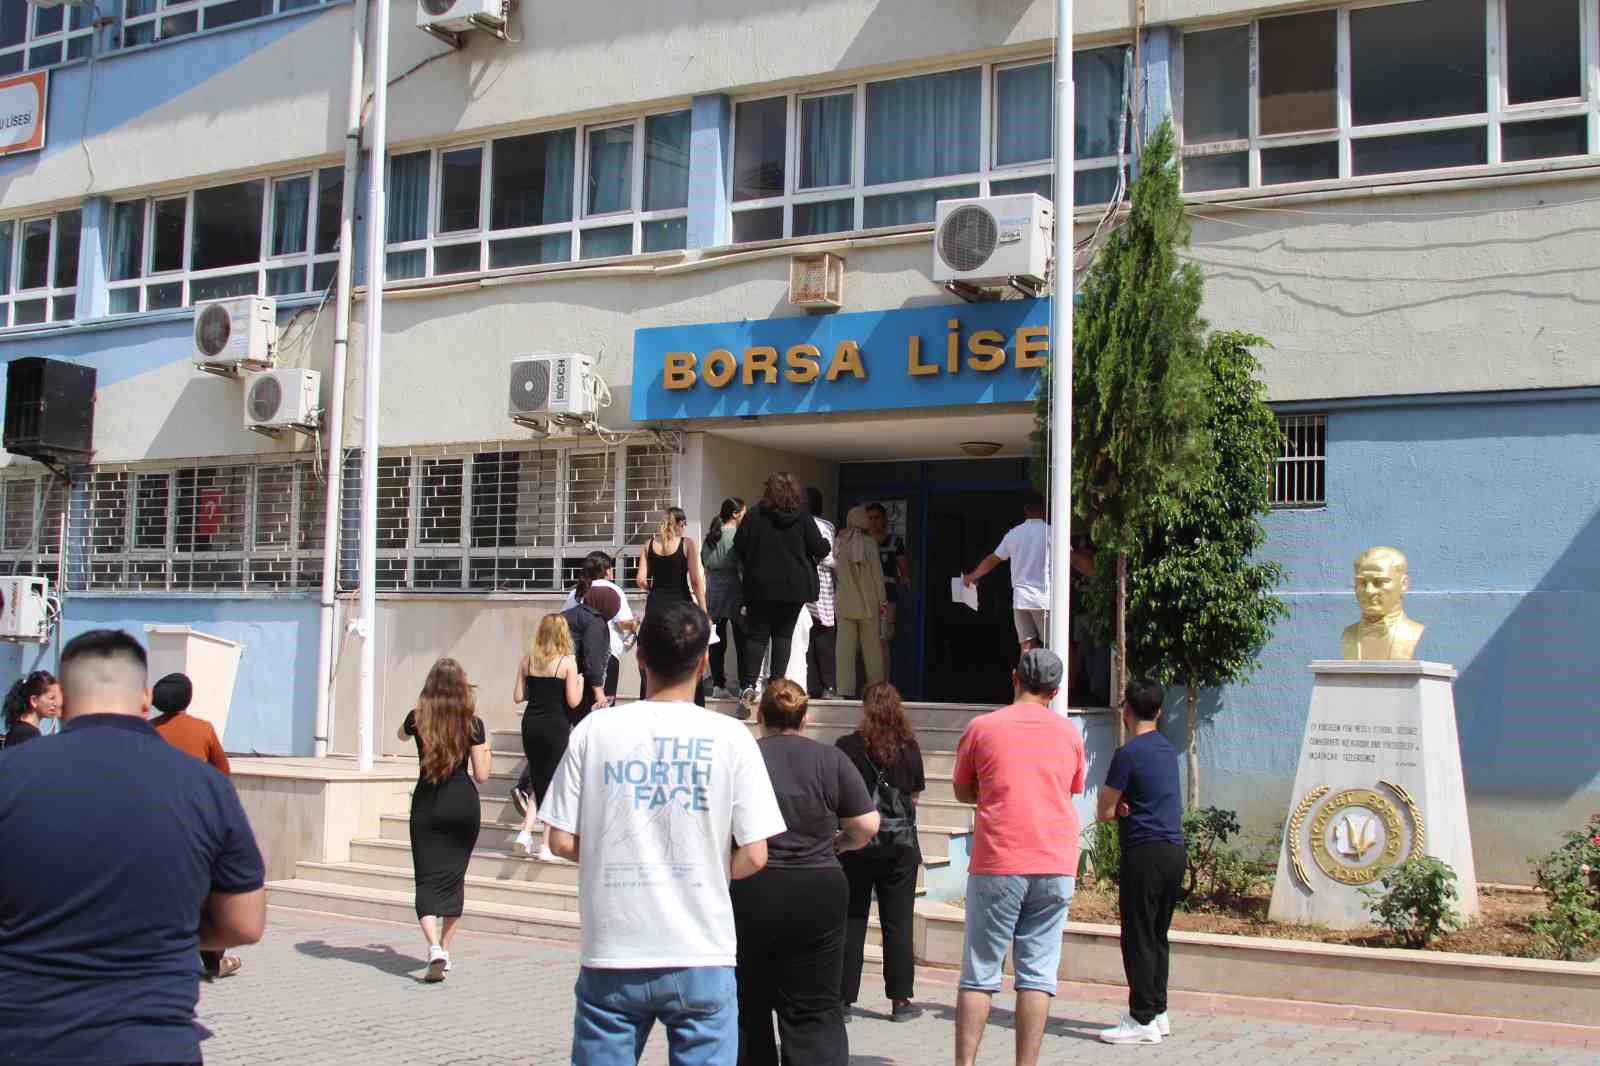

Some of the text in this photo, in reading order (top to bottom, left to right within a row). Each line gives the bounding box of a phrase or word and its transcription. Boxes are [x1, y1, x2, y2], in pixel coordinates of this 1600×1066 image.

[663, 340, 866, 390] BORSA
[556, 360, 566, 400] BOSCH
[653, 737, 715, 762] THE
[604, 760, 711, 785] NORTH
[633, 785, 710, 812] FACE
